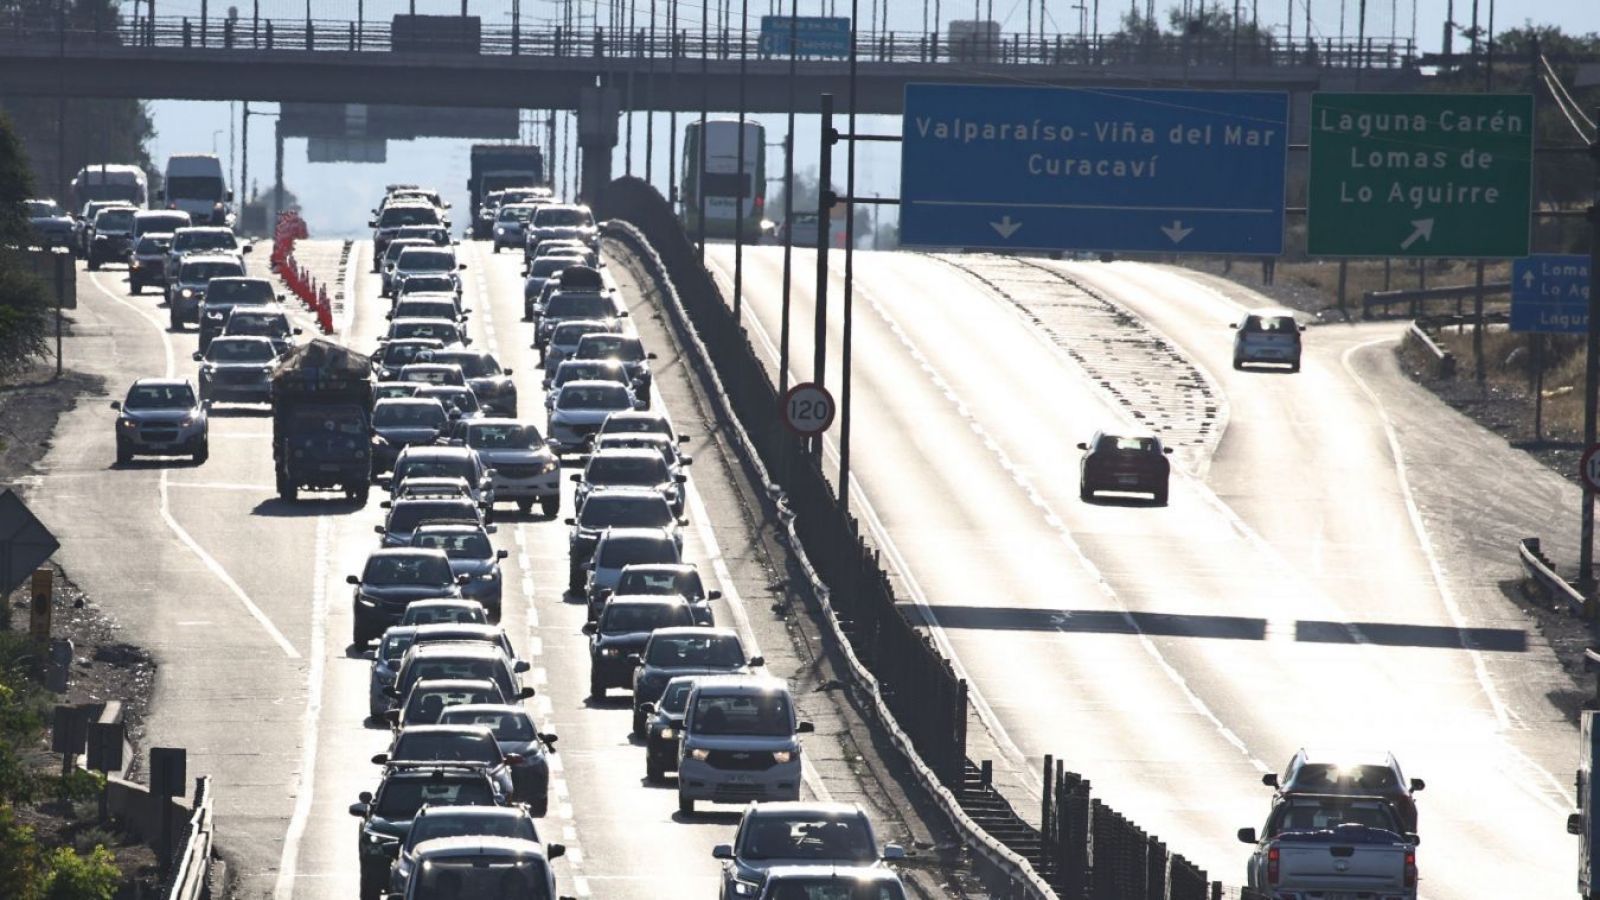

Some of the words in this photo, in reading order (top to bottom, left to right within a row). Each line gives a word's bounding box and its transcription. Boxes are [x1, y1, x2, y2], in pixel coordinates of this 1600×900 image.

[1169, 123, 1212, 145] del
[1224, 125, 1275, 146] Mar
[1320, 109, 1426, 137] Laguna
[1439, 110, 1522, 132] Carén
[1028, 153, 1159, 177] Curacaví
[1351, 147, 1448, 168] Lomas
[1460, 148, 1493, 168] de
[1341, 181, 1373, 202] Lo
[1387, 182, 1499, 209] Aguirre
[1541, 282, 1560, 296] Lo
[791, 400, 828, 420] 120
